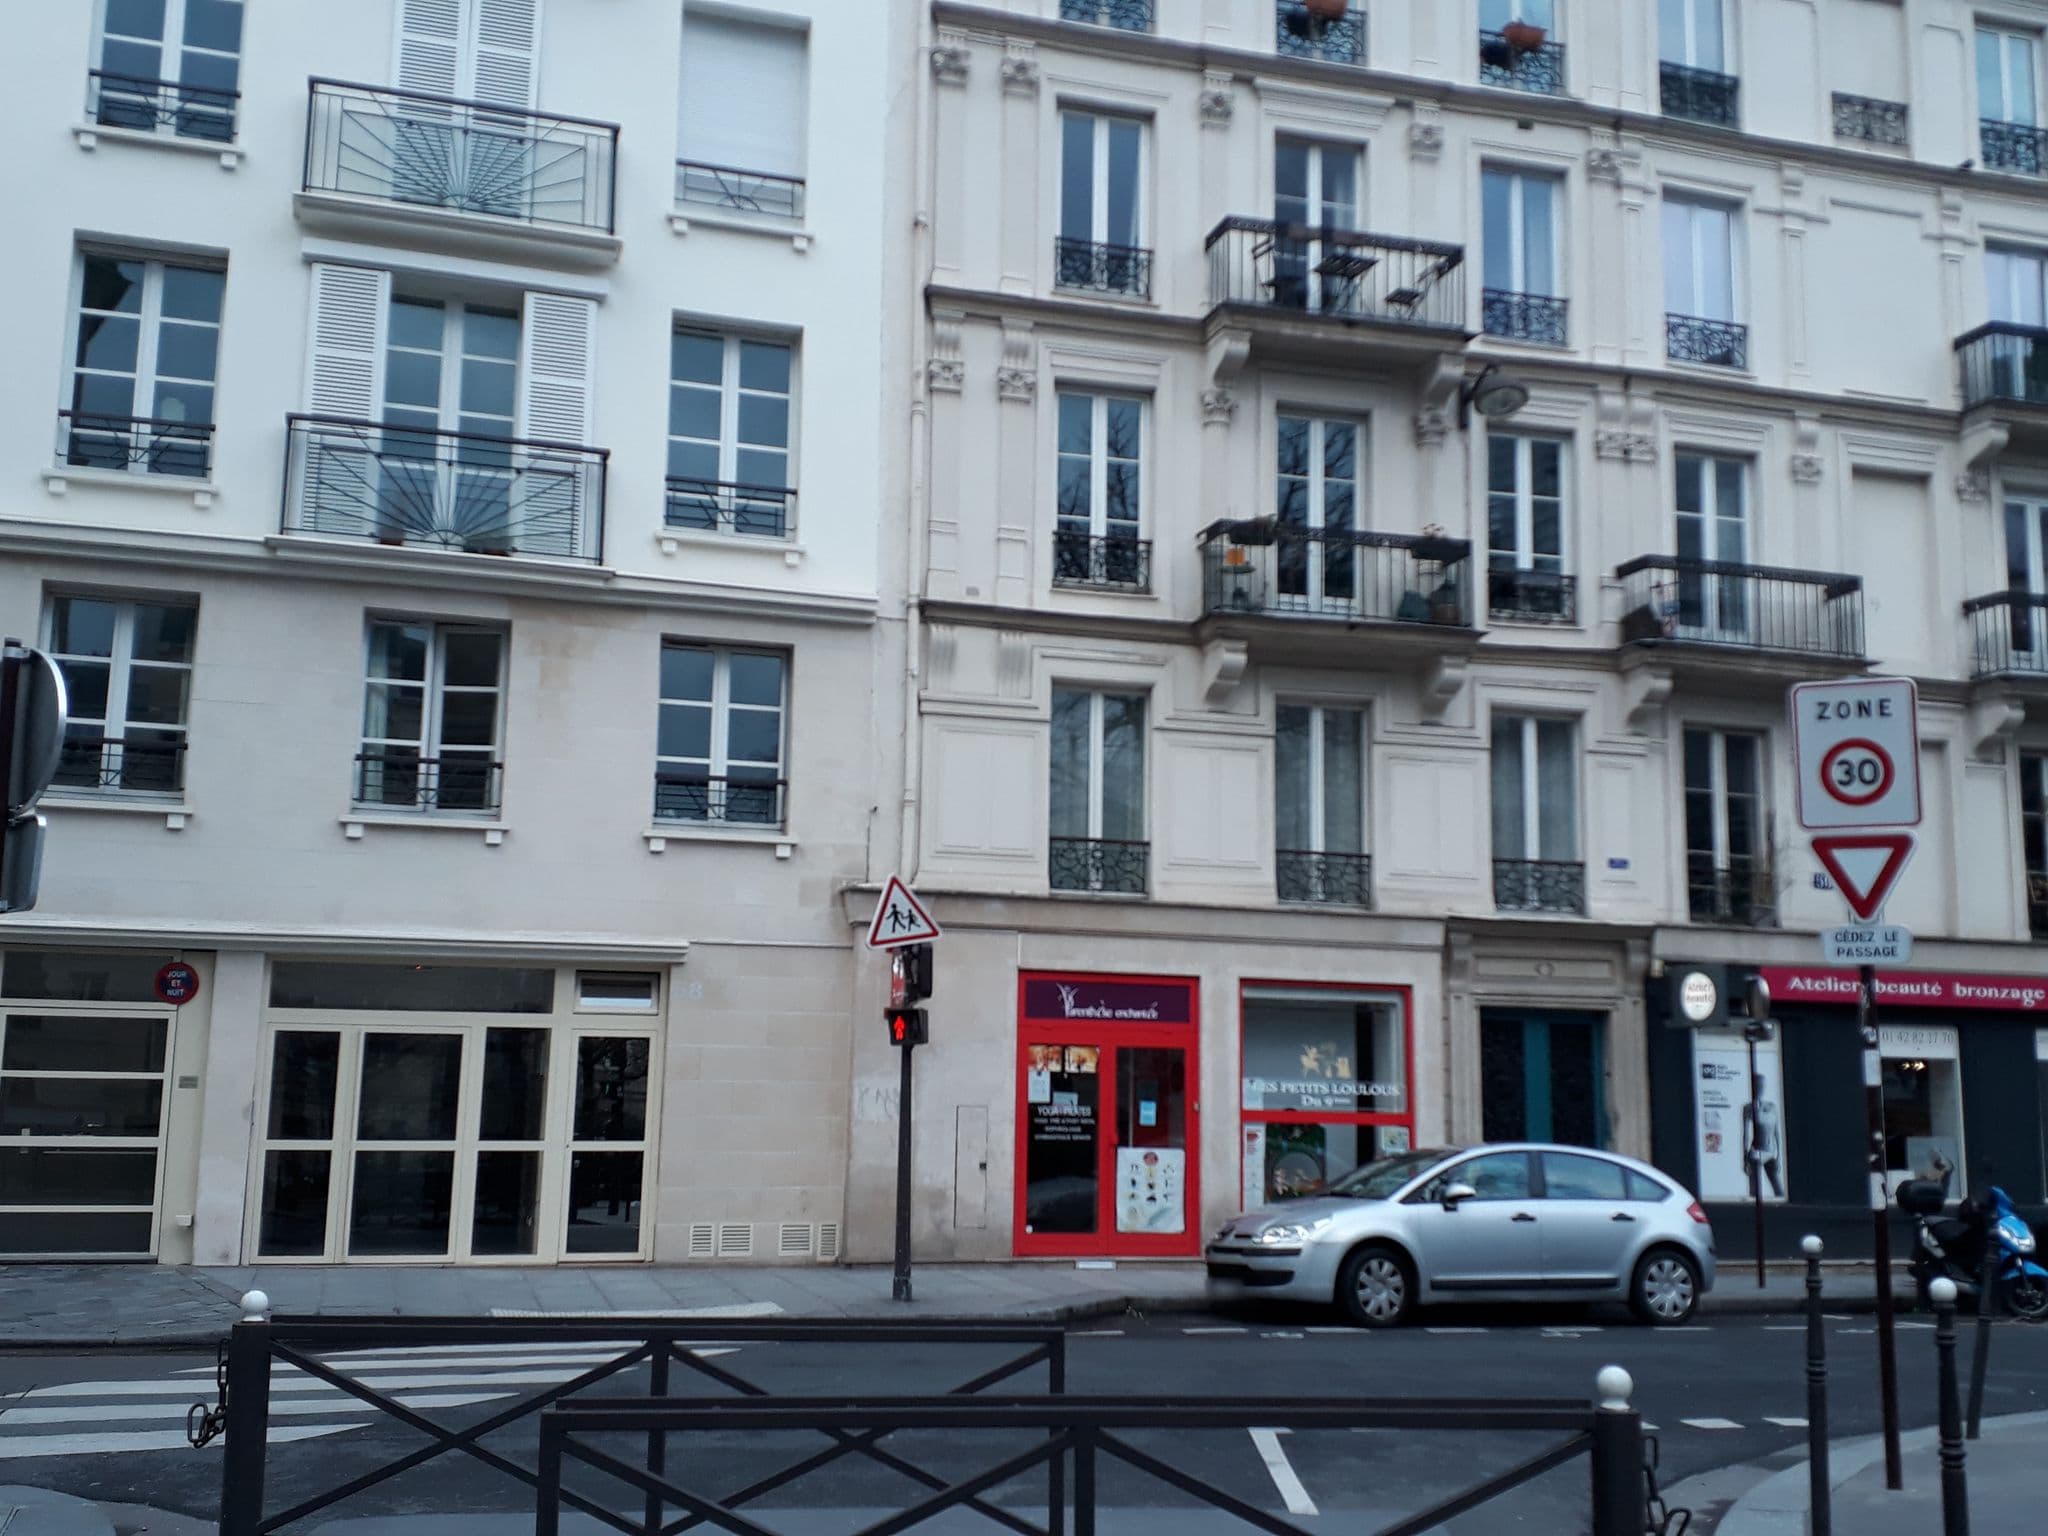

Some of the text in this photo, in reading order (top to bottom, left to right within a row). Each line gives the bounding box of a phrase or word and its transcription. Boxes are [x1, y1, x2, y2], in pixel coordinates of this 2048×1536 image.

[1816, 698, 1893, 720] ZONE
[1836, 758, 1880, 787] 30
[1834, 929, 1899, 943] CÉDEZ LE
[1836, 946, 1899, 958] PASSAGE
[168, 970, 187, 978] JOUR
[171, 979, 181, 987] ET
[166, 989, 184, 997] NUIT
[1787, 976, 2047, 1007] Atelier beauté bronzage
[1280, 1079, 1330, 1094] PETITS
[1332, 1080, 1400, 1096] LOULOUS
